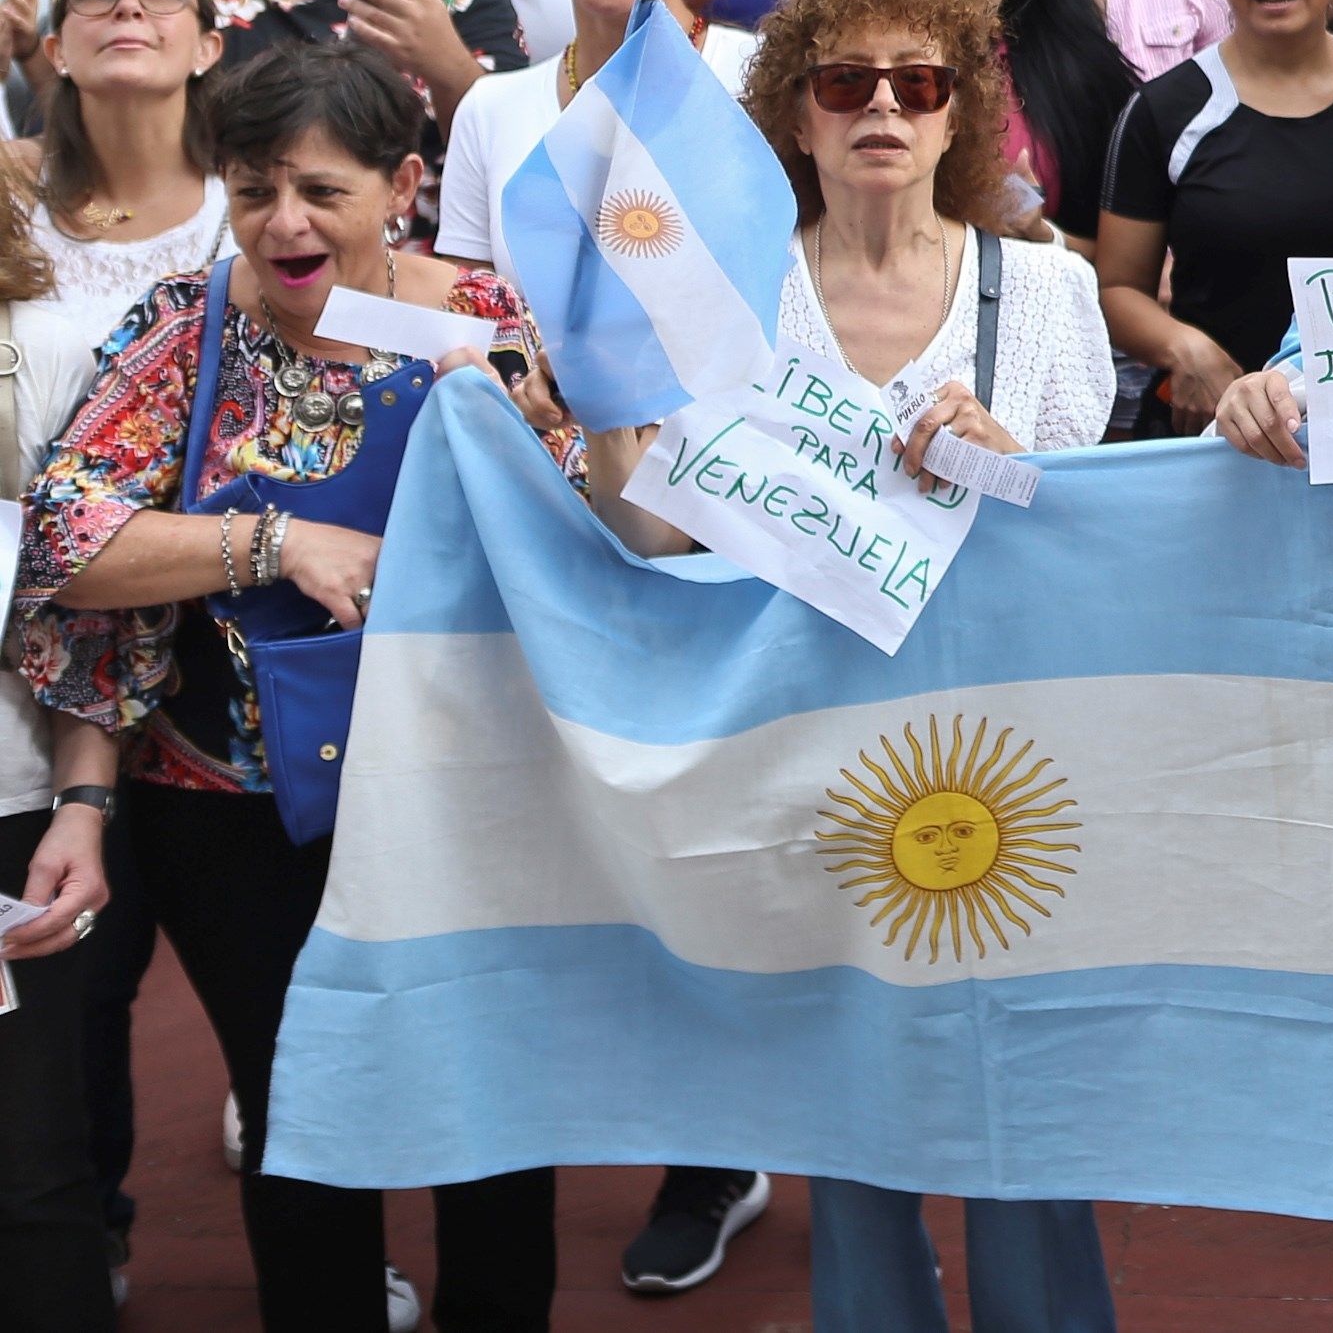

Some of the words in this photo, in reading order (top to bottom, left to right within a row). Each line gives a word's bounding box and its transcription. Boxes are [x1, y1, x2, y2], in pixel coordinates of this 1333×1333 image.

[896, 393, 926, 425] PUEBLO
[791, 425, 879, 502] PARA
[667, 417, 931, 611] VENEZUELA
